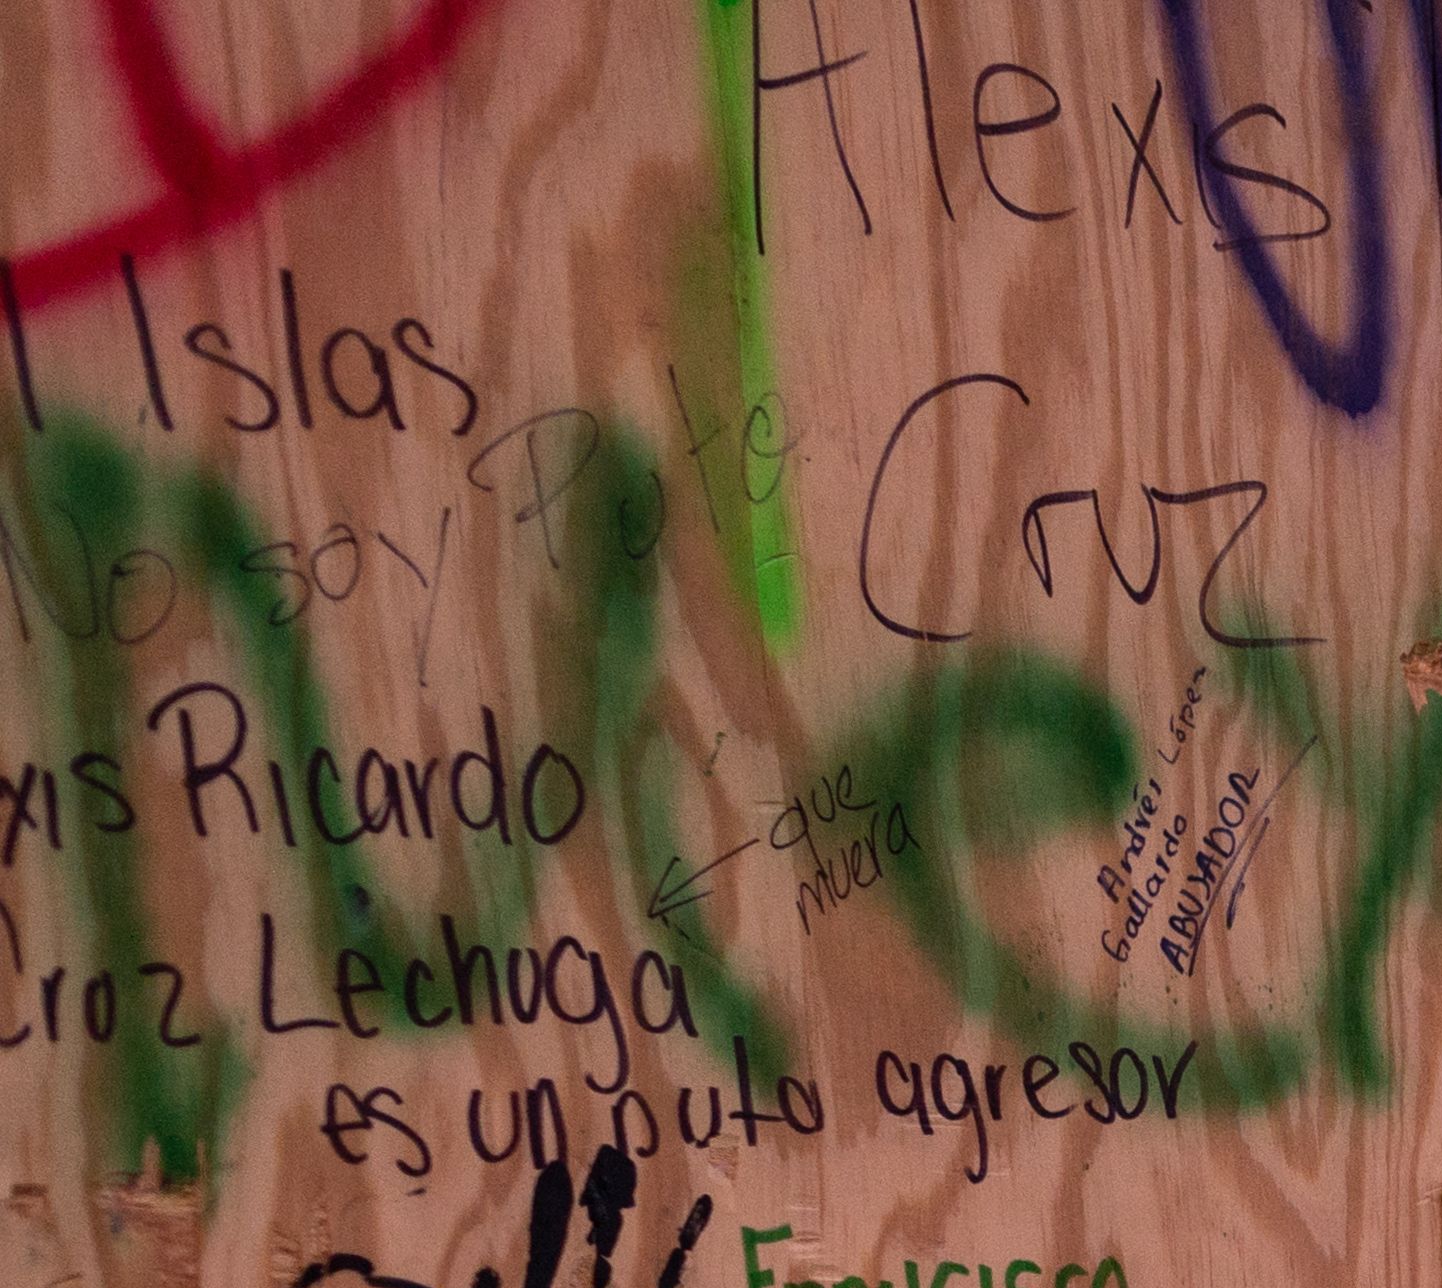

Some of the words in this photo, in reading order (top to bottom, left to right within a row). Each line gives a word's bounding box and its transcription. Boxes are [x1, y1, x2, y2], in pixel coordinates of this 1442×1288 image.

[120, 250, 482, 438] Islas
[860, 370, 1328, 650] Cruz
[147, 678, 590, 848] Ricardo
[768, 762, 878, 865] que
[793, 800, 922, 936] muera
[1098, 812, 1190, 967] Gallardo
[260, 910, 702, 1095] Lechuga
[318, 1080, 434, 1180] es
[466, 1076, 570, 1172] un
[872, 1040, 1202, 1185] agresor
